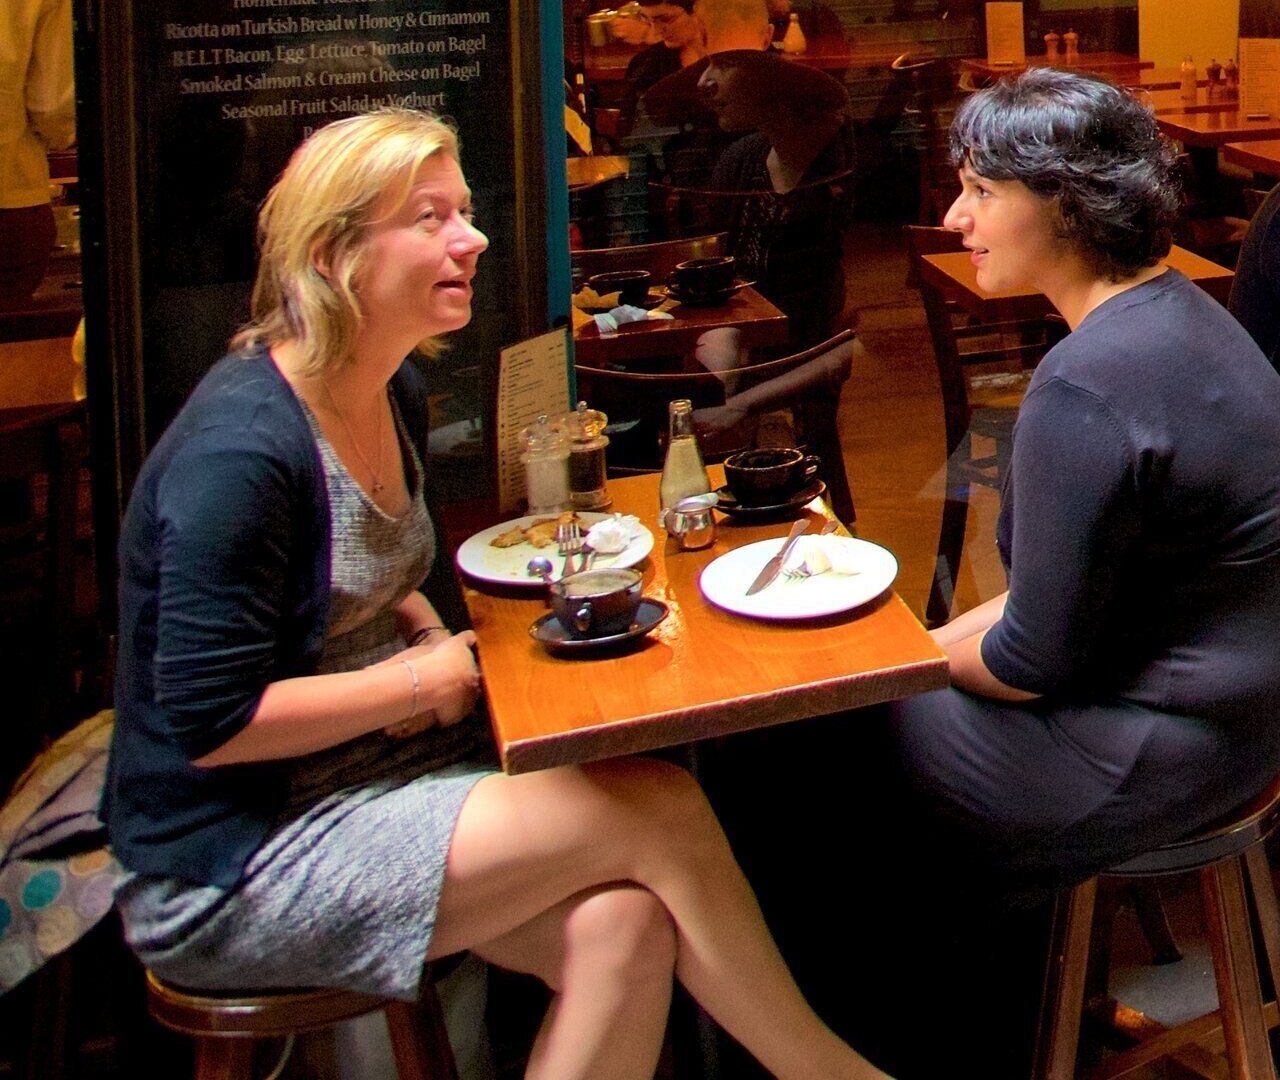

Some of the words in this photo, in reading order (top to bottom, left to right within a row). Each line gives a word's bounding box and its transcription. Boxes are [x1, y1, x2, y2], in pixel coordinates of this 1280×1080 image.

[181, 76, 241, 94] Smoked
[245, 74, 300, 90] Salmon
[305, 72, 316, 87] &
[319, 69, 366, 87] Cream
[369, 66, 418, 83] Cheese
[421, 66, 440, 81] on
[443, 62, 480, 82] Bagel
